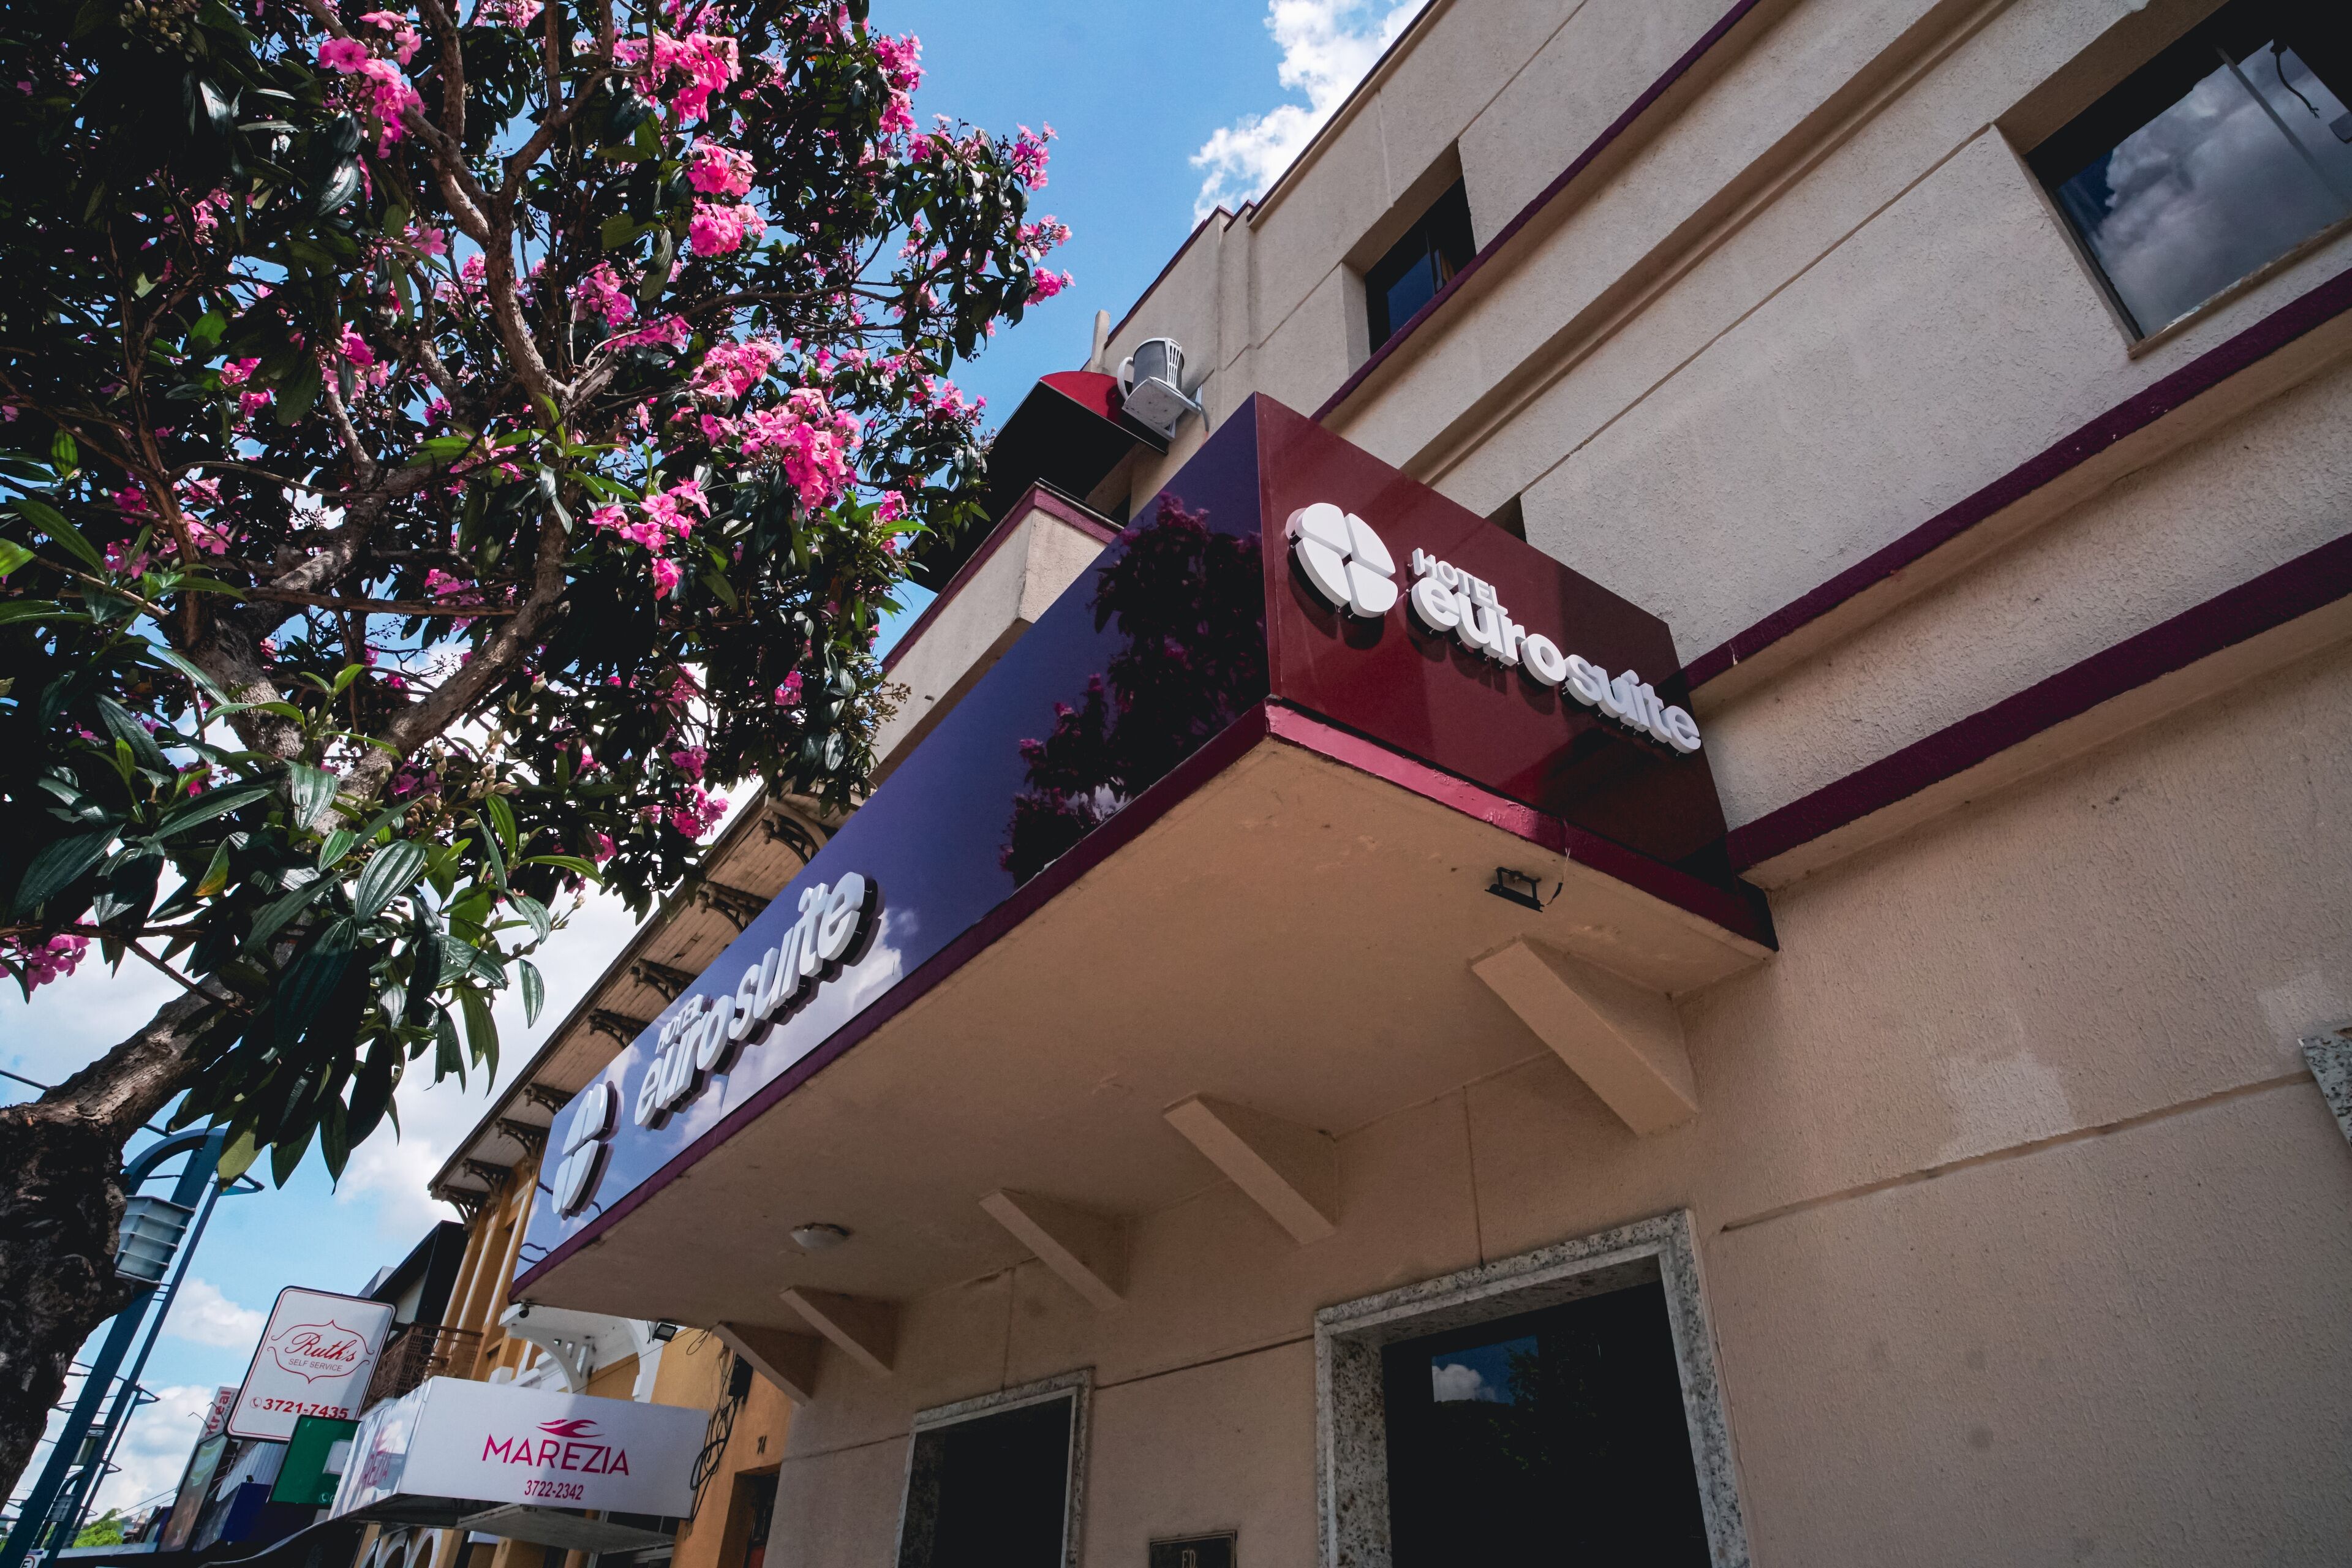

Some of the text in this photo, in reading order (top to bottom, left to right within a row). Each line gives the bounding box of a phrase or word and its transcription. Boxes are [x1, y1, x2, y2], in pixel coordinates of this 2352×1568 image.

[1412, 547, 1508, 616] HOTEL
[1411, 577, 1702, 754] eurosuite
[635, 872, 865, 1126] eurosuite
[655, 993, 704, 1055] HOTEL
[285, 1332, 357, 1362] Ruth's
[309, 1361, 342, 1372] SERVICE
[263, 1398, 349, 1419] 3721-7435
[482, 1433, 629, 1476] MAREZIA
[524, 1480, 584, 1500] 3722-2342
